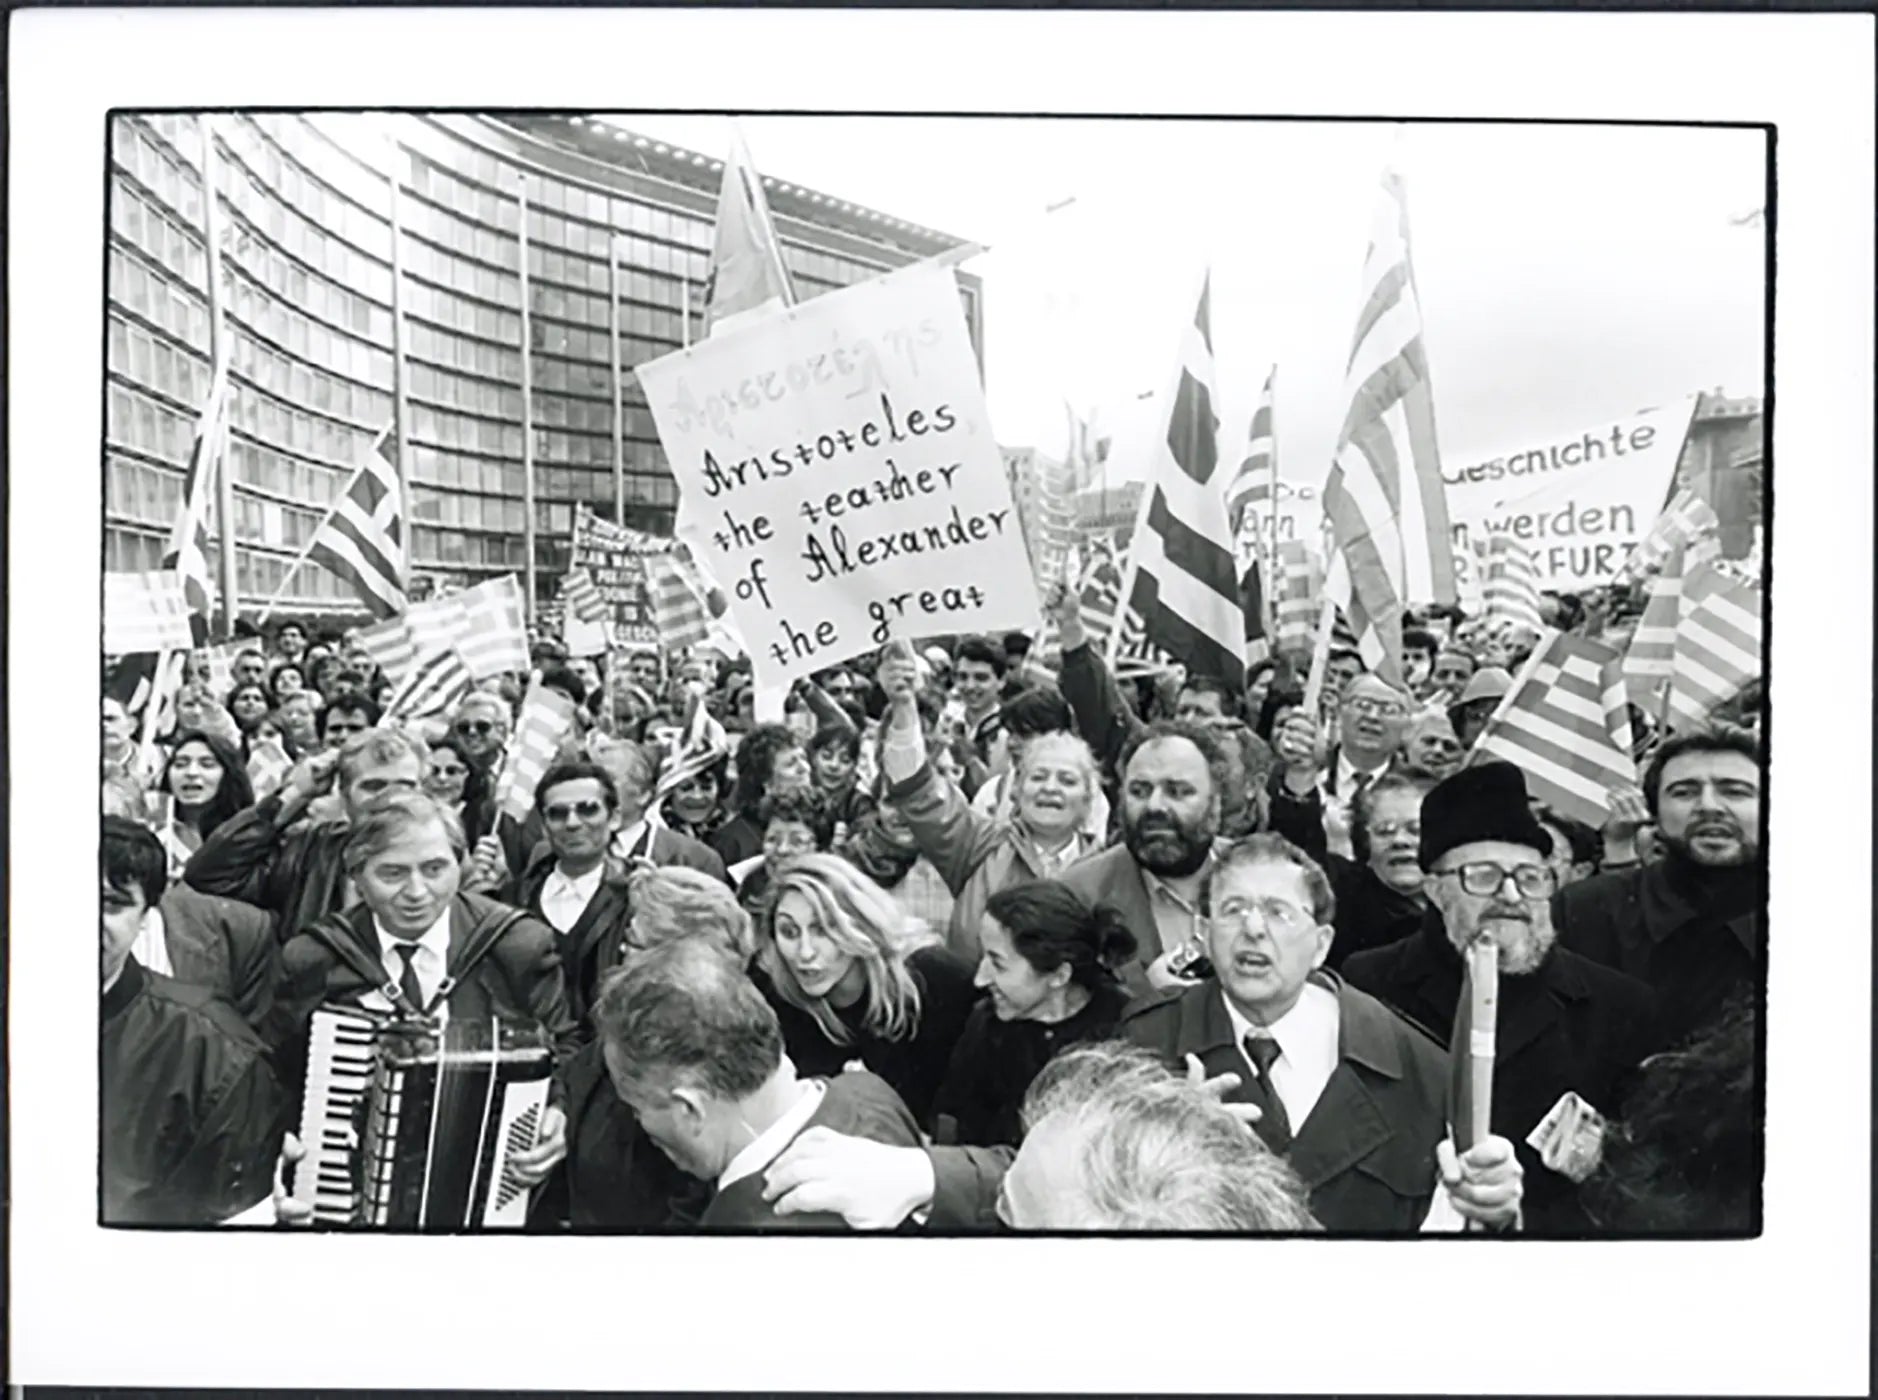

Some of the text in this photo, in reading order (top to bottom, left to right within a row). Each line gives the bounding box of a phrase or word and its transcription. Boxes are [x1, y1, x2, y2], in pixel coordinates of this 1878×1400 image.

[703, 392, 956, 498] Aristoteles
[713, 509, 774, 552] the
[735, 505, 1010, 609] of Alexander
[1483, 501, 1635, 540] werden
[769, 584, 984, 668] the great
